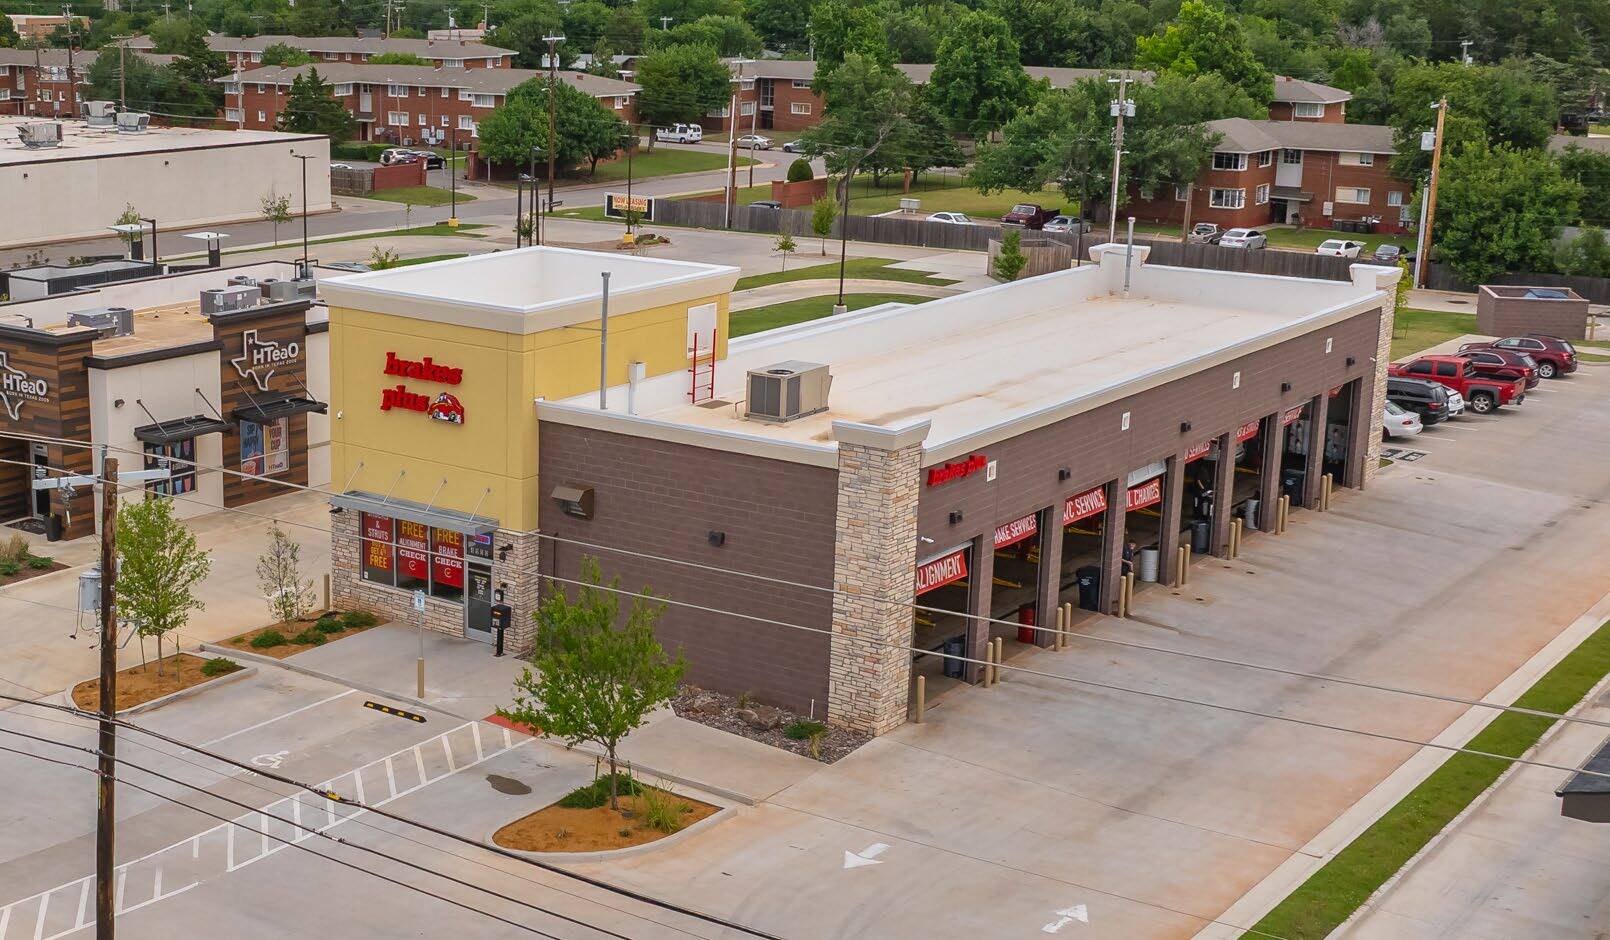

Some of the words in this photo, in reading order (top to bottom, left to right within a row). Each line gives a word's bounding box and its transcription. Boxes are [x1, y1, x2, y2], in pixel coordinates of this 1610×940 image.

[253, 343, 299, 365] HTeaO
[383, 352, 463, 385] brakes
[3, 373, 48, 396] HTeaO
[380, 385, 430, 411] plus
[1075, 489, 1105, 516] SERVICE
[368, 528, 389, 541] STRUTS
[401, 521, 424, 538] FREE
[1010, 513, 1037, 538] SERVICES
[400, 538, 426, 551] ALIGNMENT
[437, 528, 460, 546] FREE
[400, 549, 426, 562] CHECK
[438, 545, 458, 558] BRAKE
[370, 553, 388, 569] FREE
[434, 556, 462, 569] CHECK
[916, 554, 961, 591] ALIGNMENT
